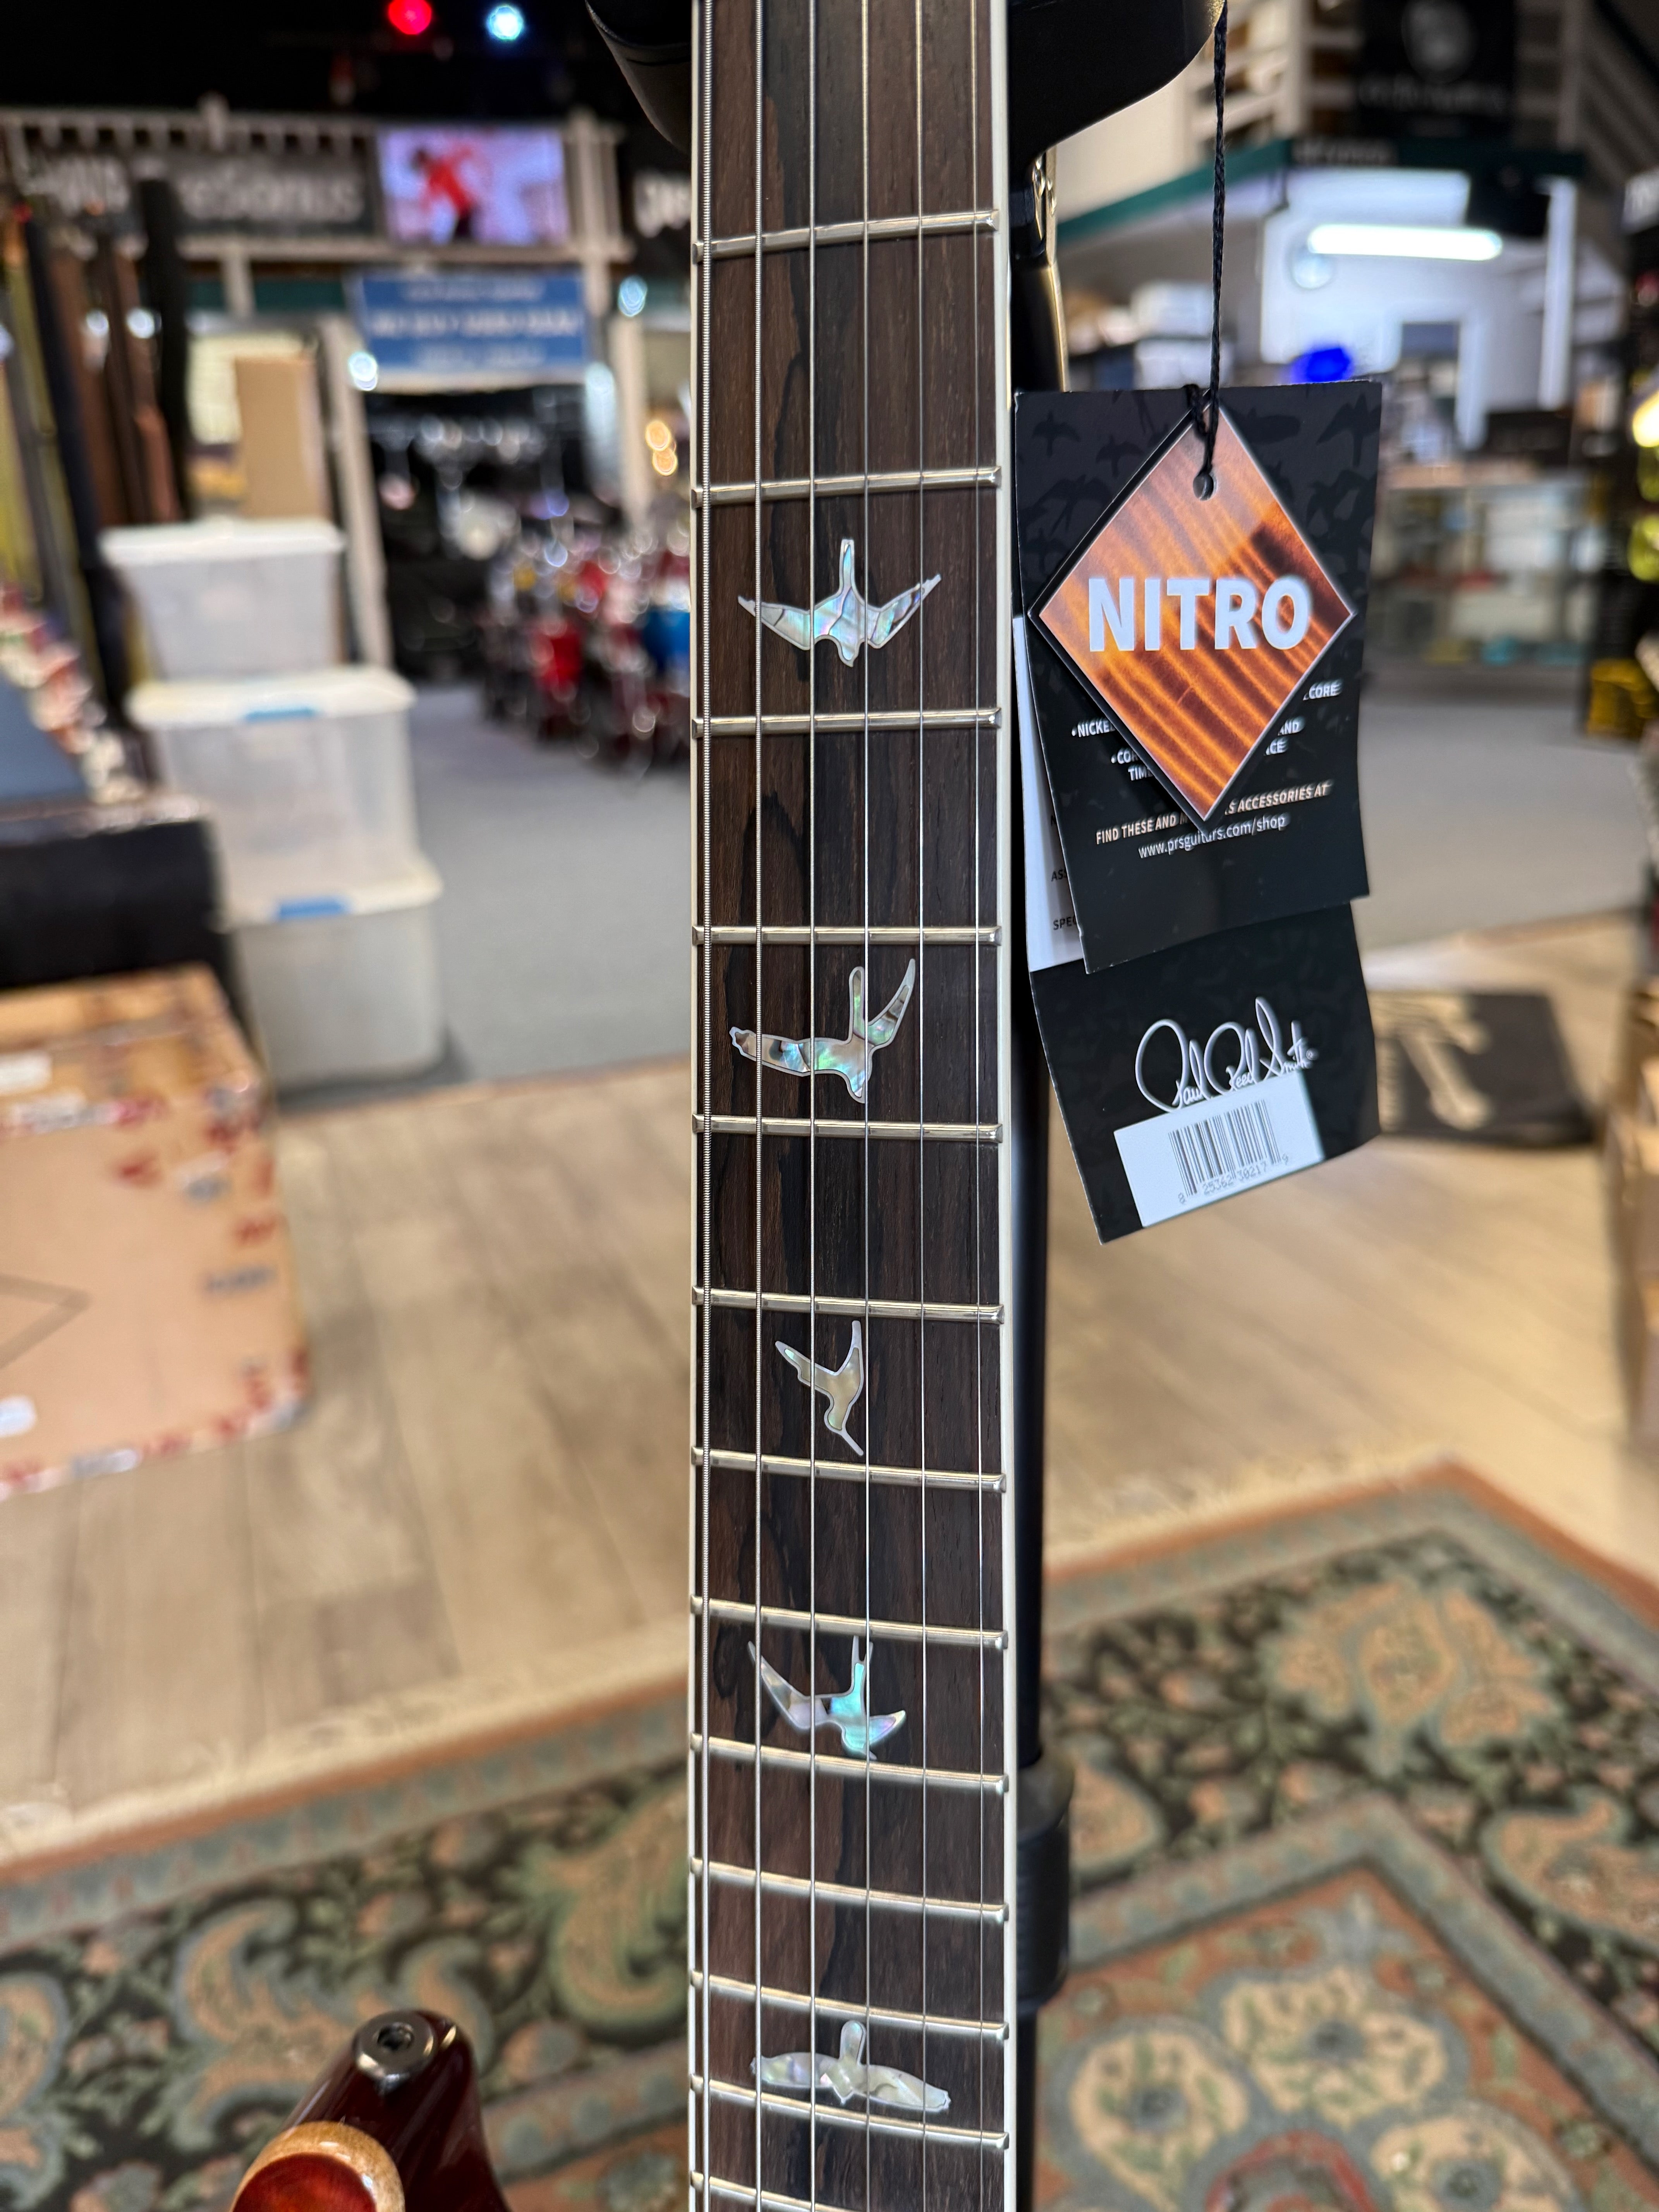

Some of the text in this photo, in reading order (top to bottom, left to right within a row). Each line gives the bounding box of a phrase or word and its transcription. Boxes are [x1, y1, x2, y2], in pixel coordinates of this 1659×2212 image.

[1088, 576, 1312, 652] NITRO
[1309, 680, 1343, 699] CORE
[1096, 825, 1120, 845] FIND
[1121, 816, 1155, 838] THESE
[1155, 812, 1179, 830] AND
[1237, 785, 1314, 812] ACCESSORIES
[1314, 779, 1334, 797] AT
